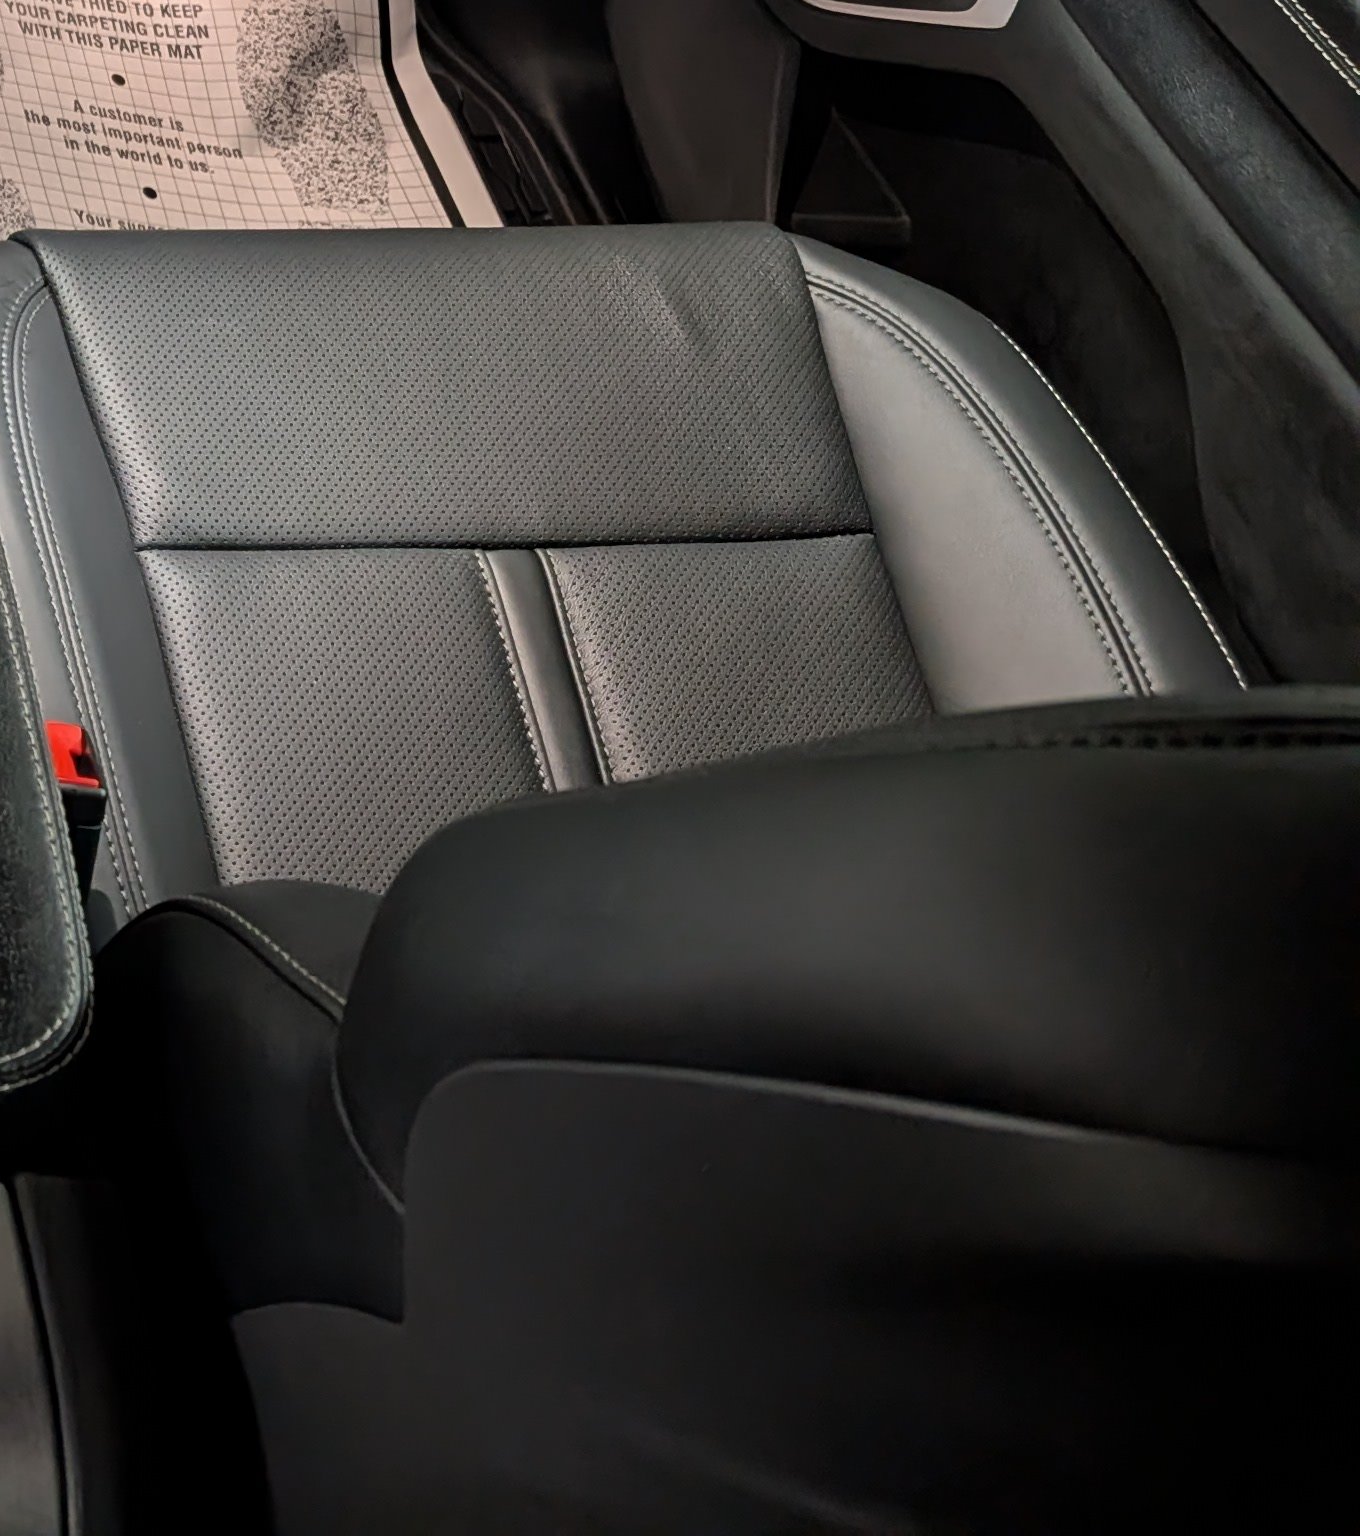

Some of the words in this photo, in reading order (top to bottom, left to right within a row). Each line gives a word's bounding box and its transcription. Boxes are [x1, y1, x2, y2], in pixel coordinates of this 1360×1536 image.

[4, 0, 51, 21] YOUR
[55, 10, 148, 37] CARPETING
[152, 23, 209, 39] CLEAN
[132, 2, 154, 17] TO
[160, 3, 203, 19] KEEP
[17, 19, 62, 41] WITH
[65, 28, 104, 49] THIS
[108, 36, 162, 58] PAPER
[168, 43, 203, 60] MAT
[24, 109, 51, 127] the
[57, 118, 97, 135] most
[102, 123, 182, 150] important
[186, 140, 243, 159] person
[73, 99, 85, 114] A
[89, 104, 163, 129] customer
[169, 117, 184, 132] is
[63, 136, 79, 151] in
[85, 140, 111, 156] the
[116, 146, 163, 166] world
[167, 154, 184, 169] to
[188, 160, 215, 174] us.
[74, 208, 112, 229] Your
